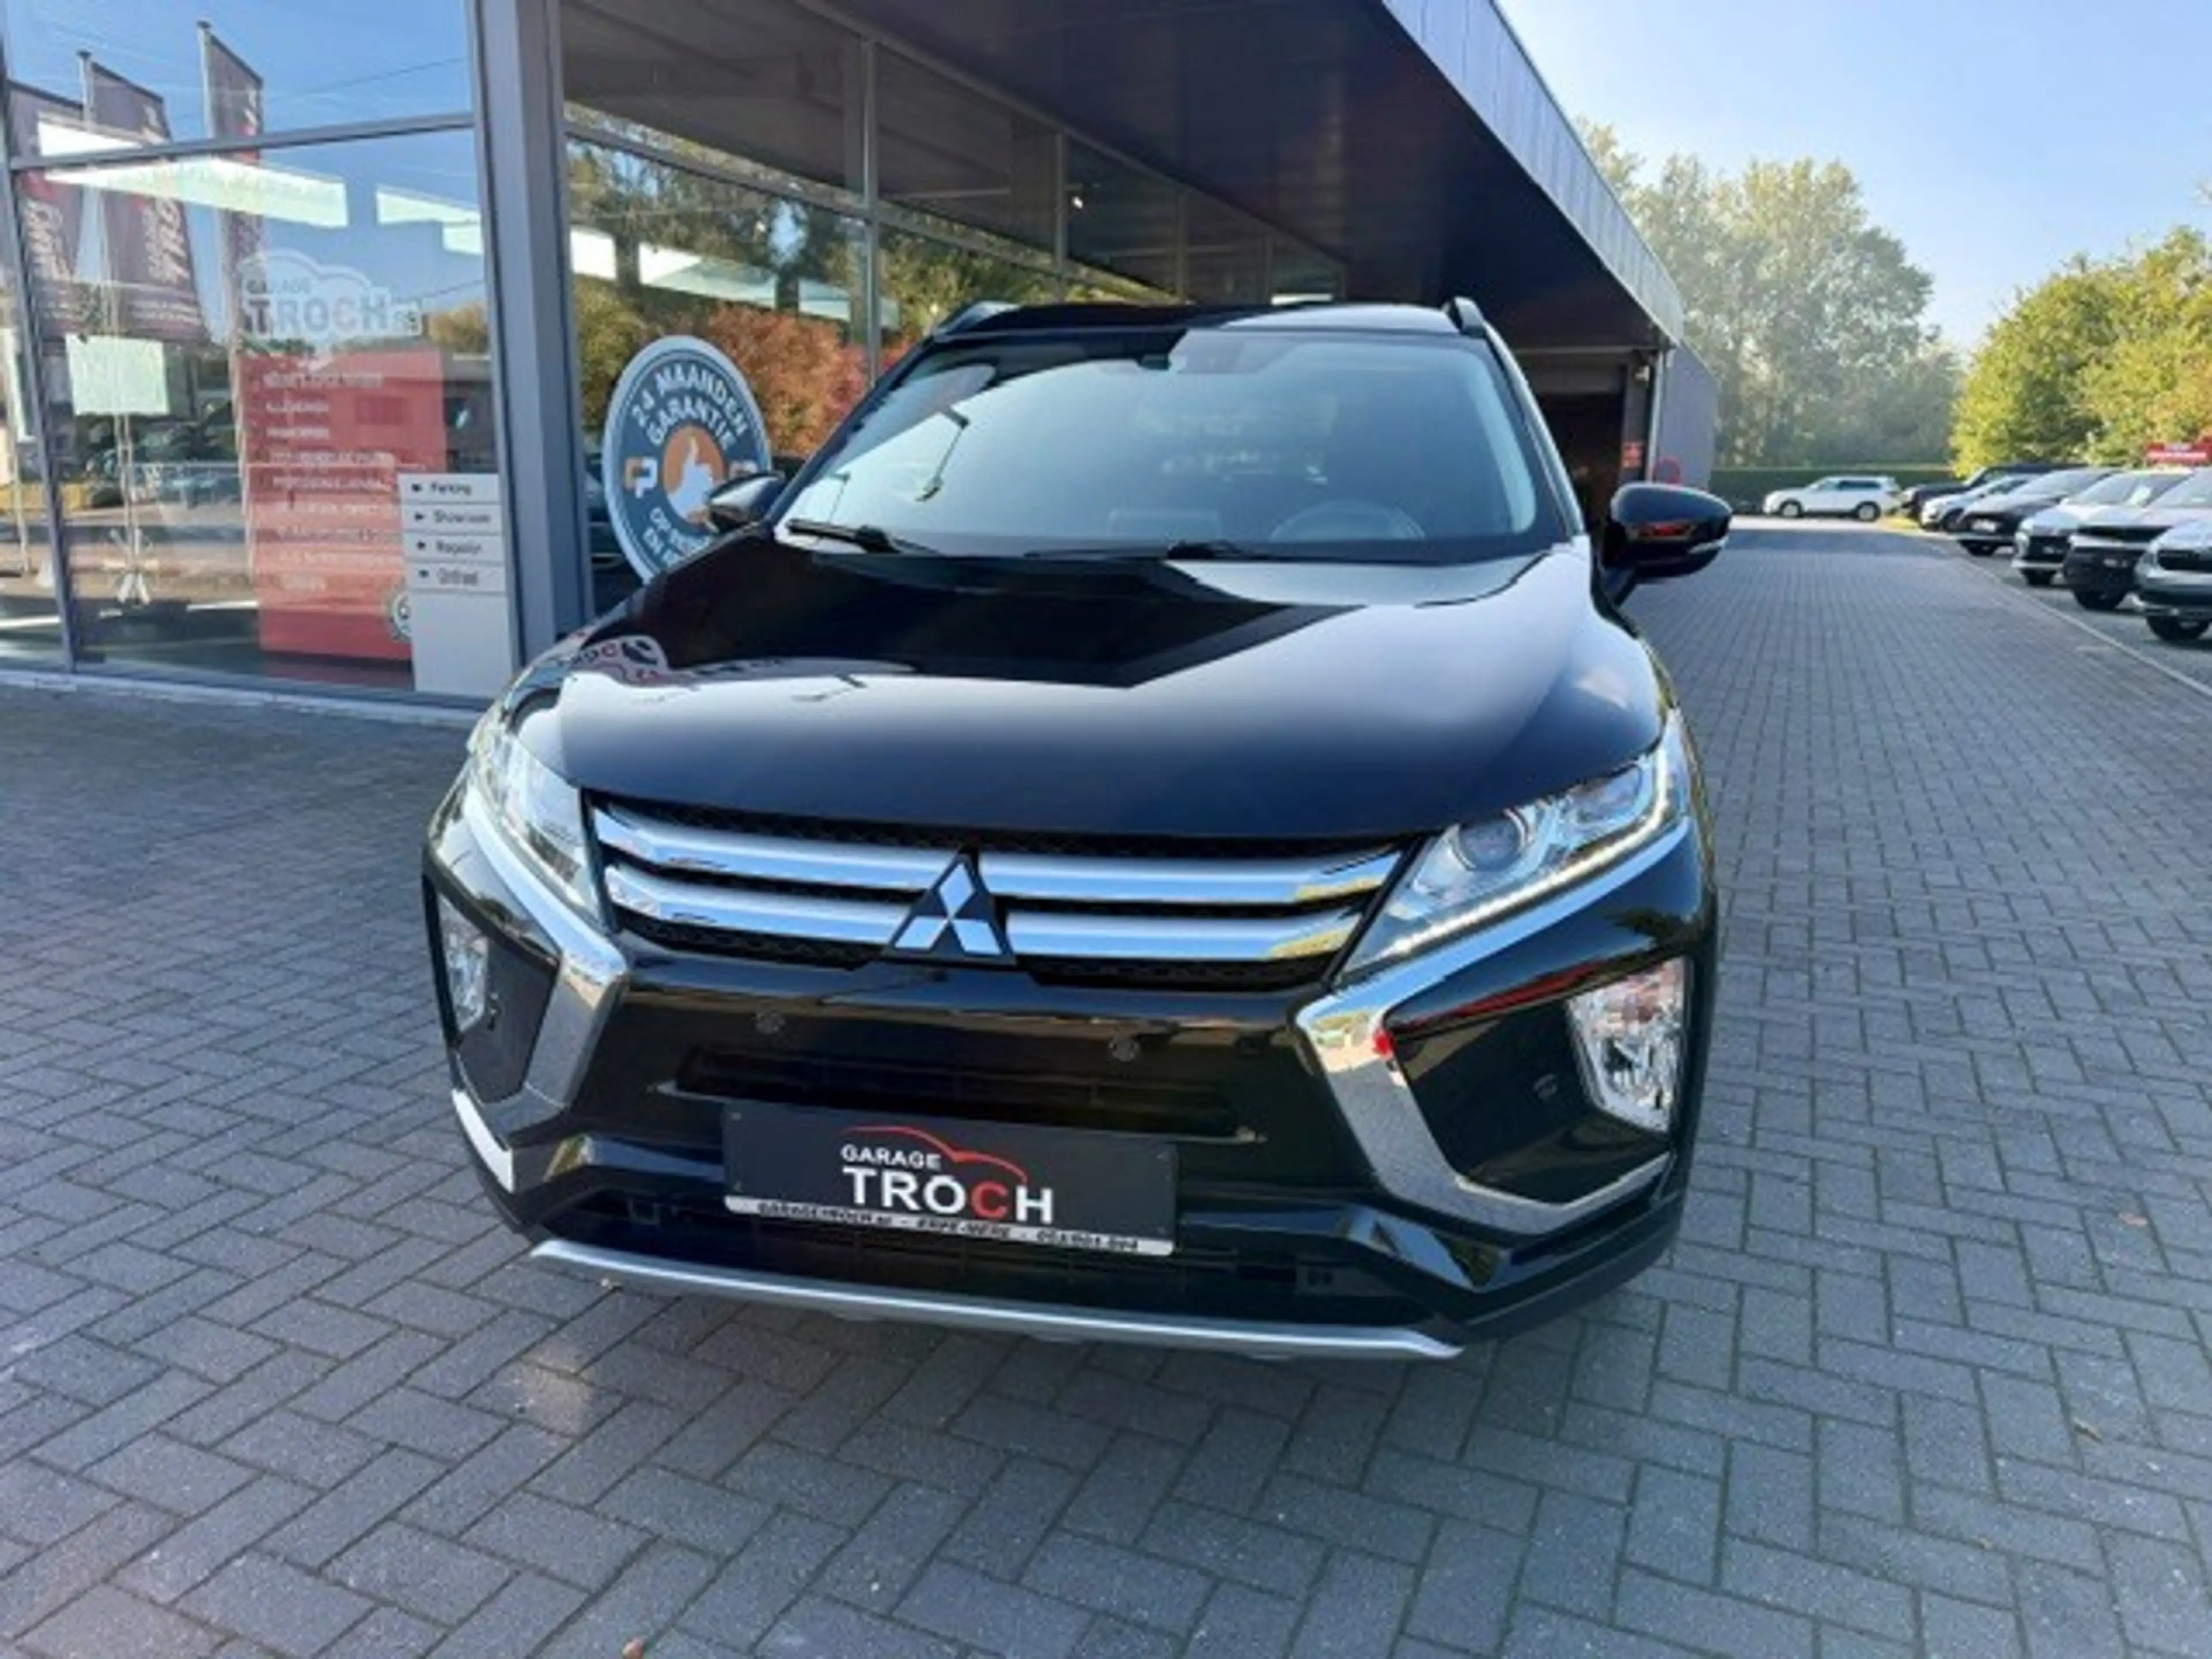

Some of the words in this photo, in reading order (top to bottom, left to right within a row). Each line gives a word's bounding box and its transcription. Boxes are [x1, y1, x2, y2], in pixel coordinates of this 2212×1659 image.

[248, 297, 390, 333] TROCH
[654, 363, 748, 436] MAANDEN
[646, 395, 737, 450] GARANTIE
[430, 482, 472, 497] Parking
[433, 510, 491, 523] Showroom
[840, 1143, 942, 1171] GARAGE
[842, 1165, 1054, 1224] TROCH
